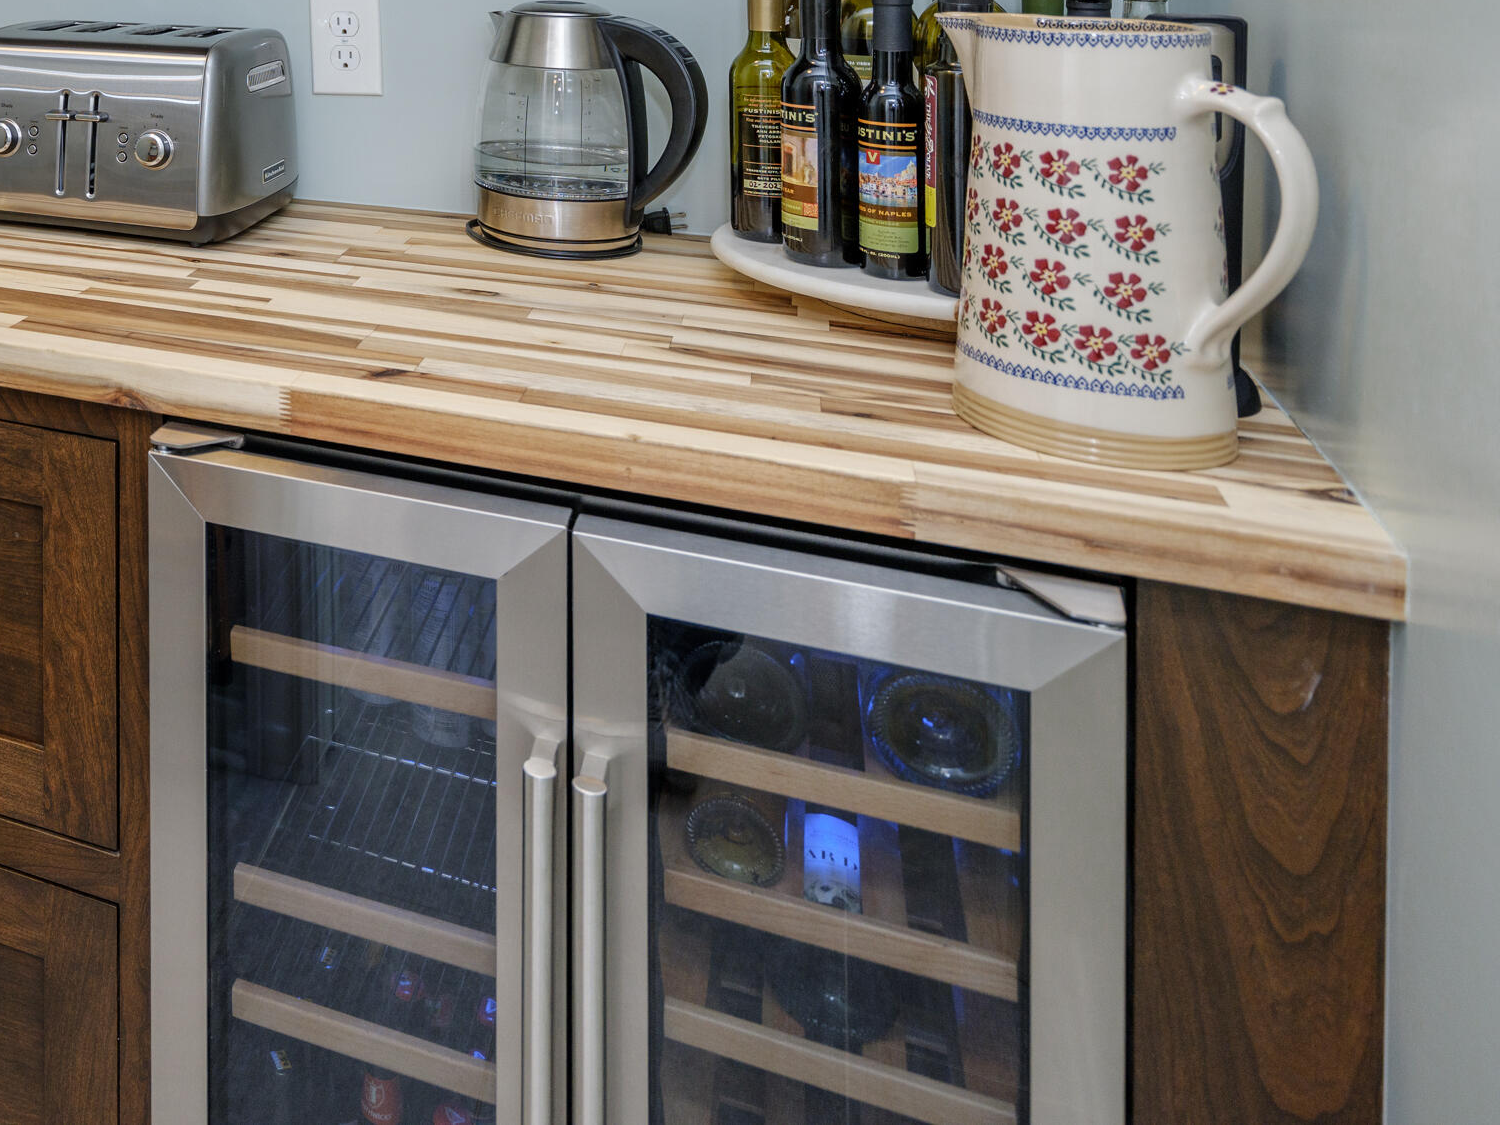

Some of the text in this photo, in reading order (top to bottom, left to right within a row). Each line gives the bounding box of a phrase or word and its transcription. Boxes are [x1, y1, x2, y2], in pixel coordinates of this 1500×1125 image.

[867, 151, 879, 163] V
[867, 207, 877, 215] OF
[878, 209, 913, 218] NAPLES
